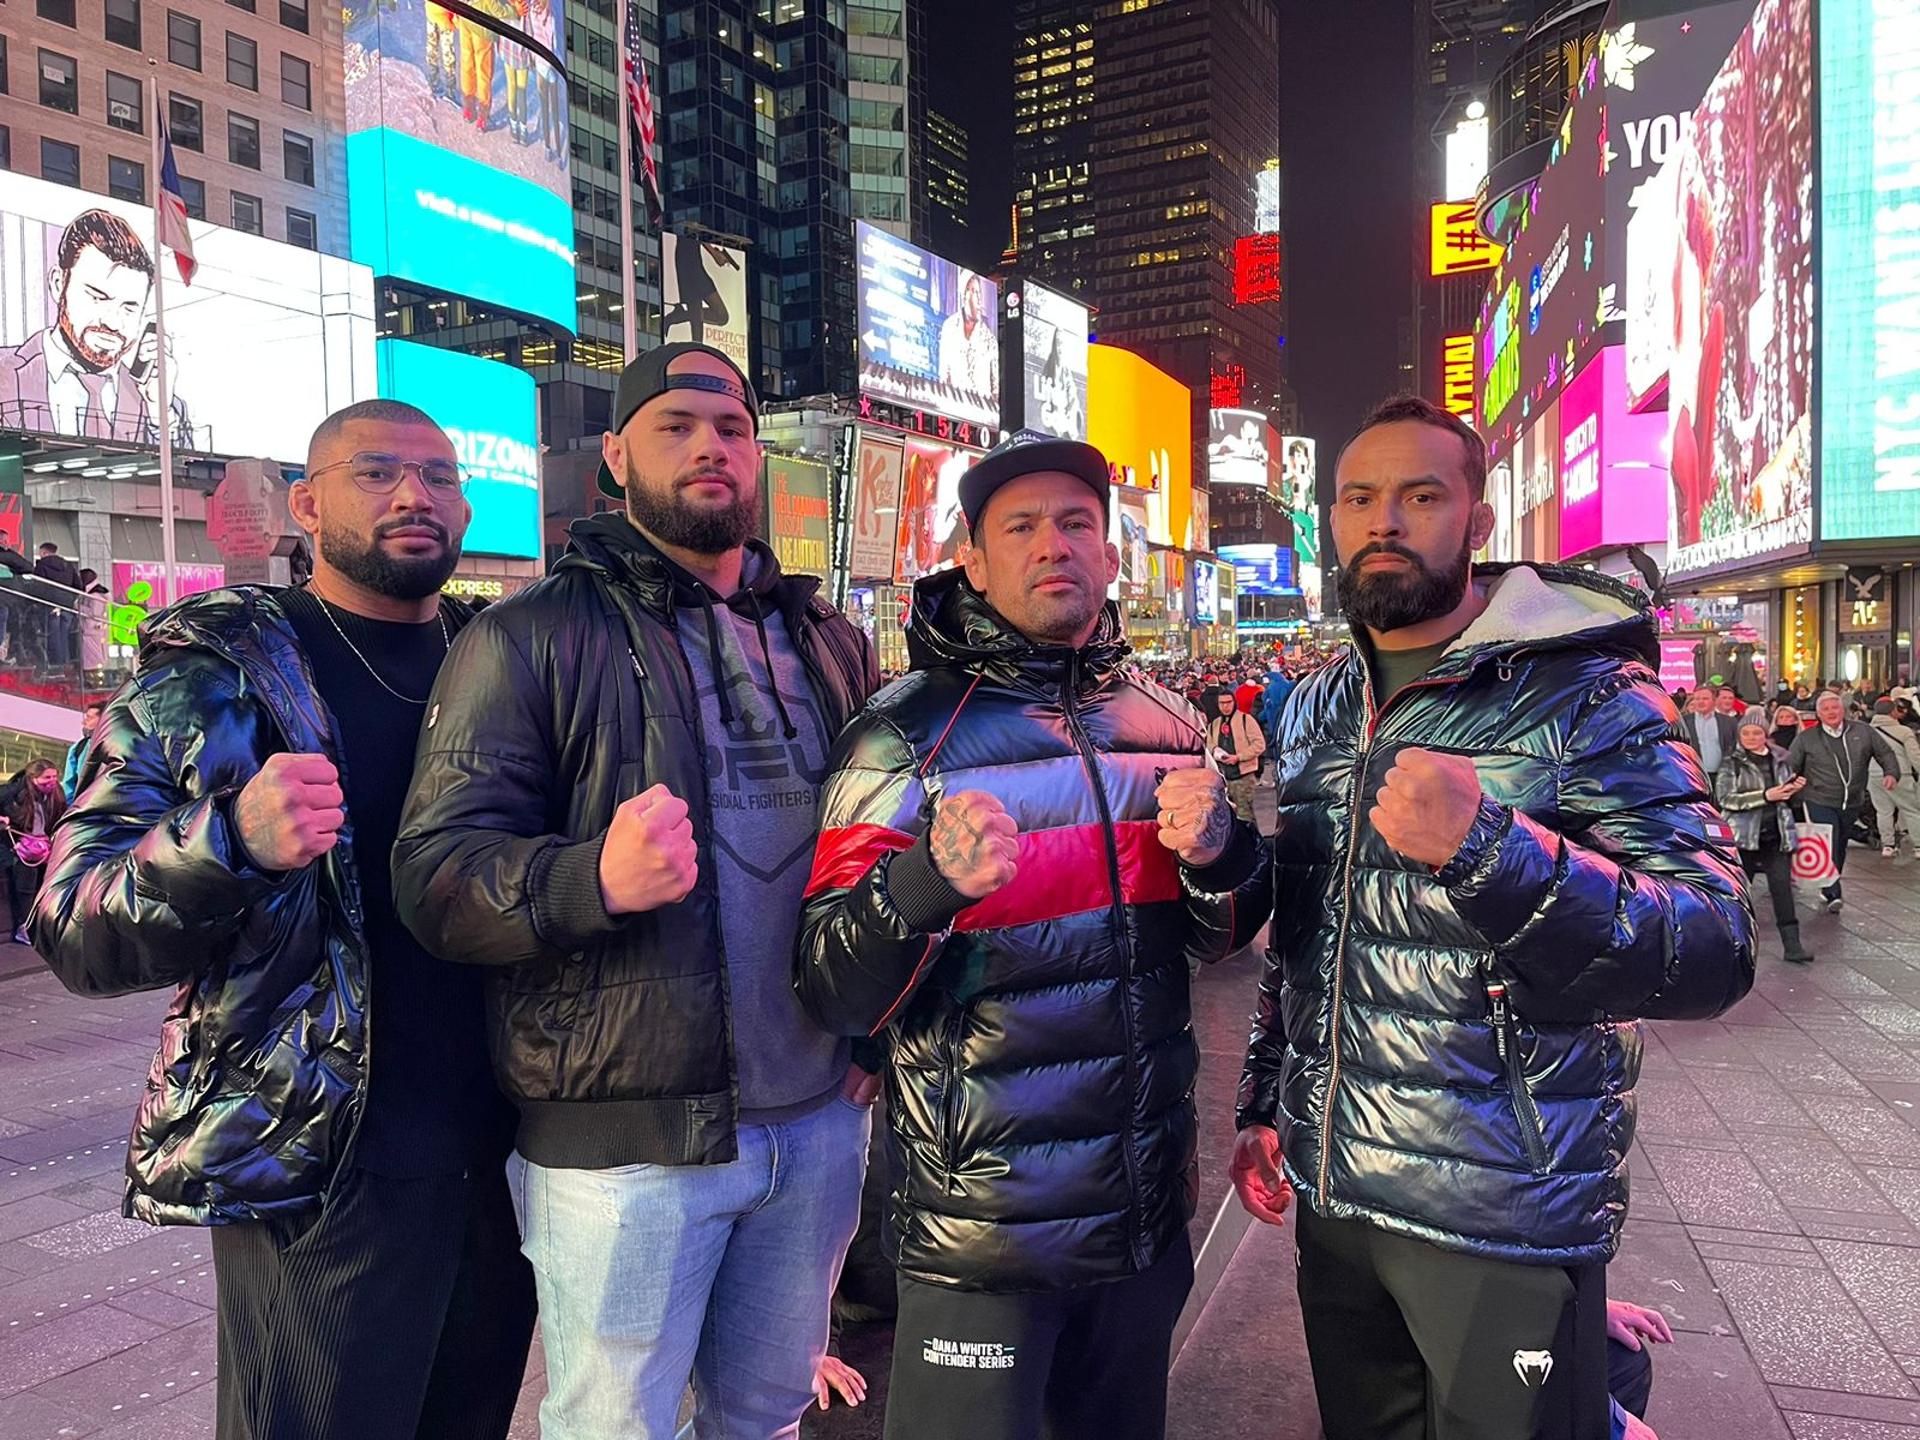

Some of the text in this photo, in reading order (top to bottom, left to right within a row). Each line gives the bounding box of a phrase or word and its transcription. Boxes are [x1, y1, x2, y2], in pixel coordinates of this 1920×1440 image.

[1007, 308, 1019, 318] LG
[705, 327, 746, 347] PERFECT
[773, 471, 788, 493] THE
[1518, 460, 1555, 519] EPHORA
[782, 537, 826, 569] BEAUTIFUL
[441, 579, 503, 597] EXPRESS
[711, 791, 747, 811] SIONAL
[749, 789, 812, 810] FIGHTERS
[1497, 1027, 1506, 1056] HILFIGER
[932, 1338, 1003, 1356] DANA WHITE'S
[923, 1348, 1015, 1369] CONTENDER SERIES
